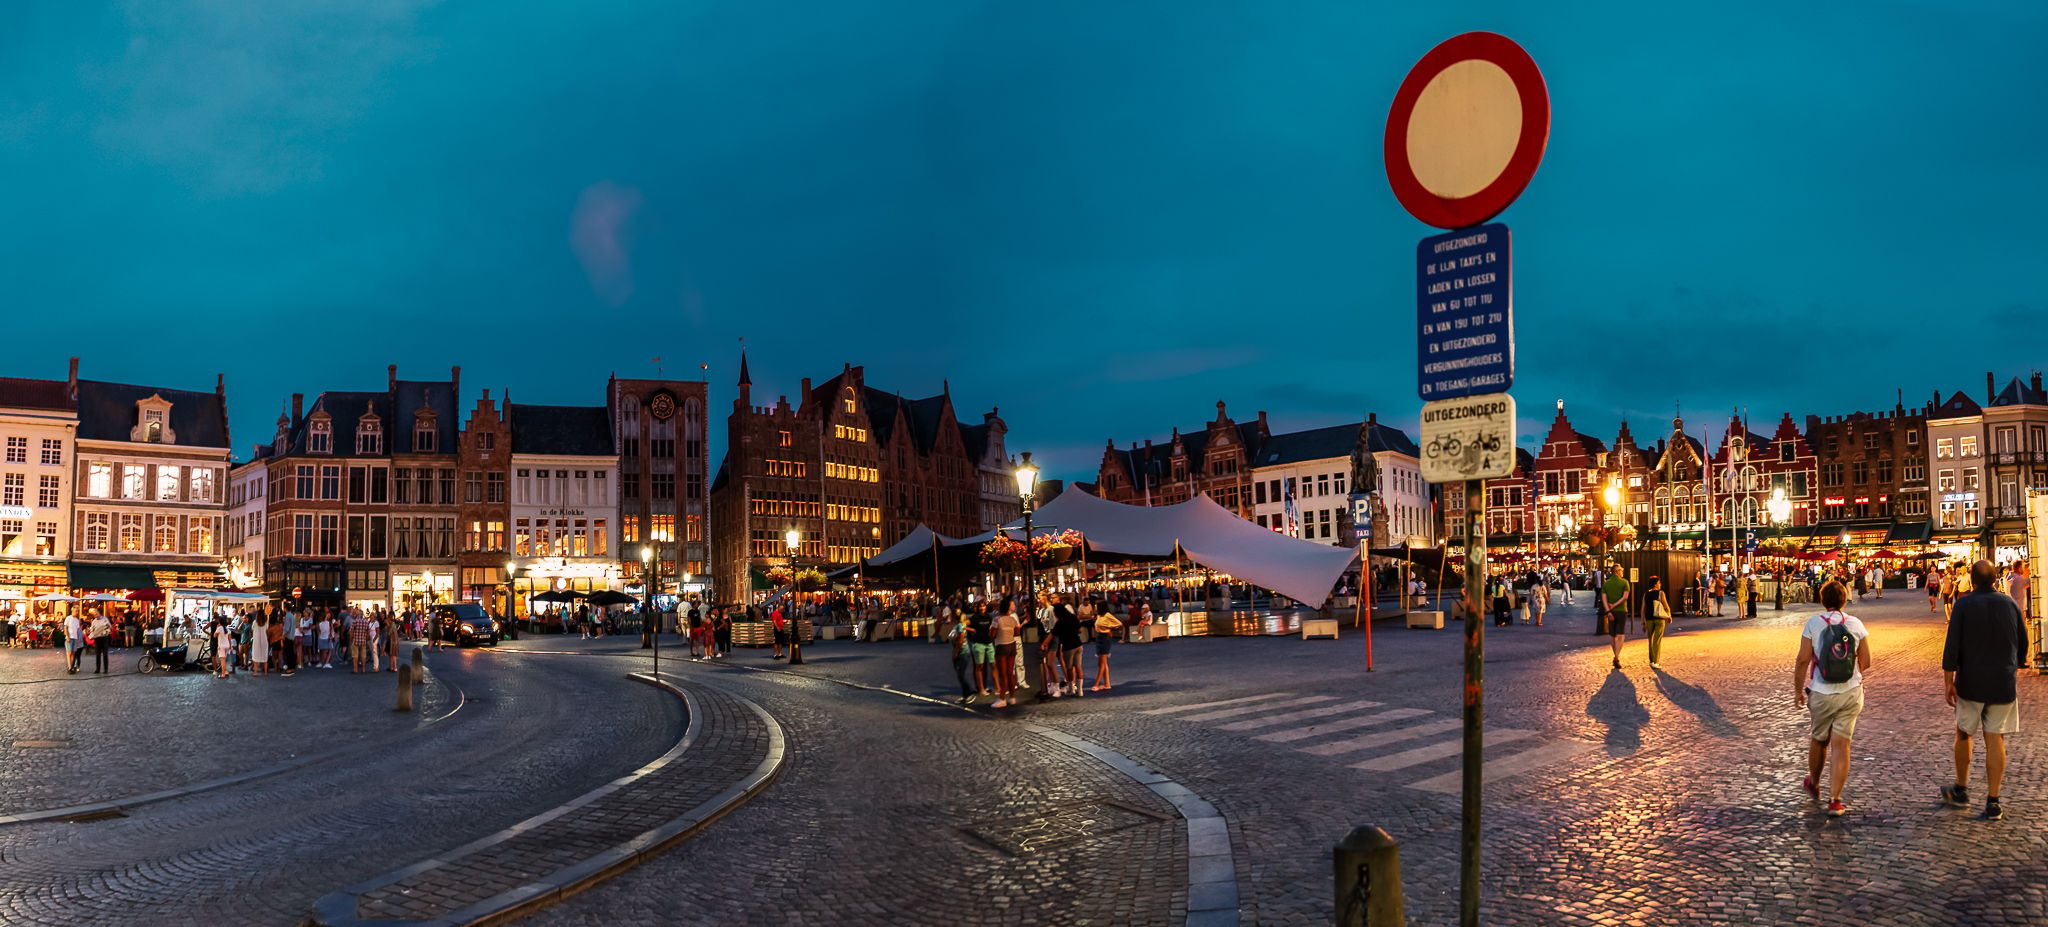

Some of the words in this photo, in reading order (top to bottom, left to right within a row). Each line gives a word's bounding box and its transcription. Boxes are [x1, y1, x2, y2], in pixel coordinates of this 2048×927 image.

[1434, 233, 1487, 253] UITGEZONDERD
[1427, 264, 1437, 275] DE
[1440, 260, 1456, 272] LIJN
[1460, 255, 1483, 268] TAXI'S
[1486, 252, 1496, 263] EN
[1428, 281, 1451, 295] LADEN
[1454, 278, 1464, 290] EN
[1468, 272, 1496, 287] LOSSEN
[1432, 300, 1447, 314] VAN
[1450, 298, 1460, 311] 6U
[1464, 295, 1477, 308] TOT
[1480, 293, 1493, 305] 11U
[1424, 324, 1434, 335] EN
[1436, 320, 1452, 332] VAN
[1455, 317, 1468, 329] 19U
[1472, 314, 1485, 326] TOT
[1488, 312, 1502, 323] 21U
[1429, 342, 1439, 354] EN
[1442, 333, 1496, 351] UITGEZONDERD
[1422, 383, 1432, 394] EN
[1424, 402, 1506, 422] UITGEZONDERD
[1482, 456, 1491, 470] A
[1355, 499, 1368, 524] P
[1746, 532, 1755, 544] P
